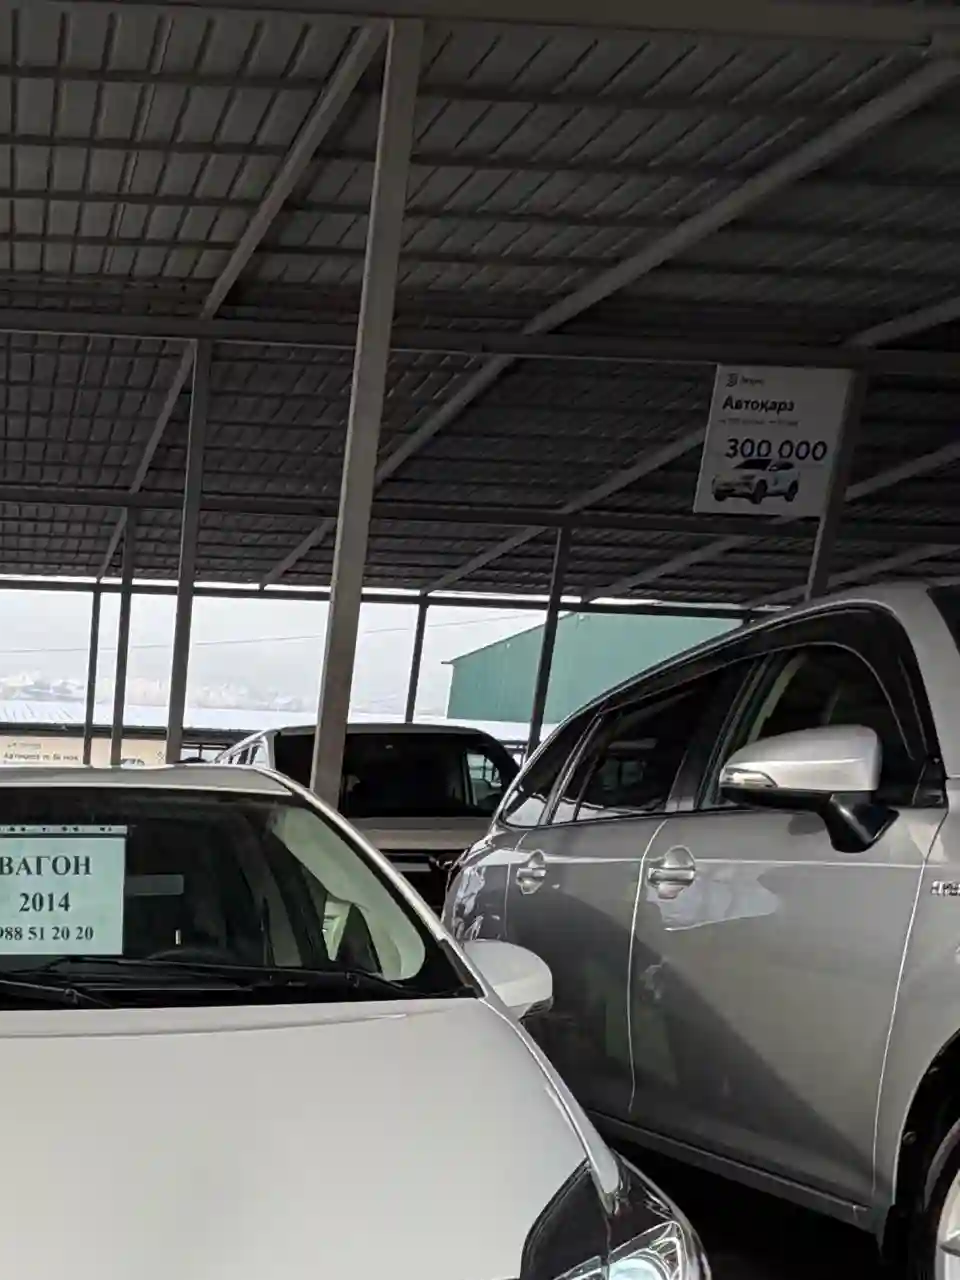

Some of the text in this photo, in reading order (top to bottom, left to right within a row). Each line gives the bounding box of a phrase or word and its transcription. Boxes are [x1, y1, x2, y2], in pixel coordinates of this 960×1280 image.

[725, 437, 828, 461] 300 000
[18, 891, 71, 913] 2014
[28, 926, 45, 941] 51
[51, 926, 71, 941] 20
[75, 926, 94, 941] 20
